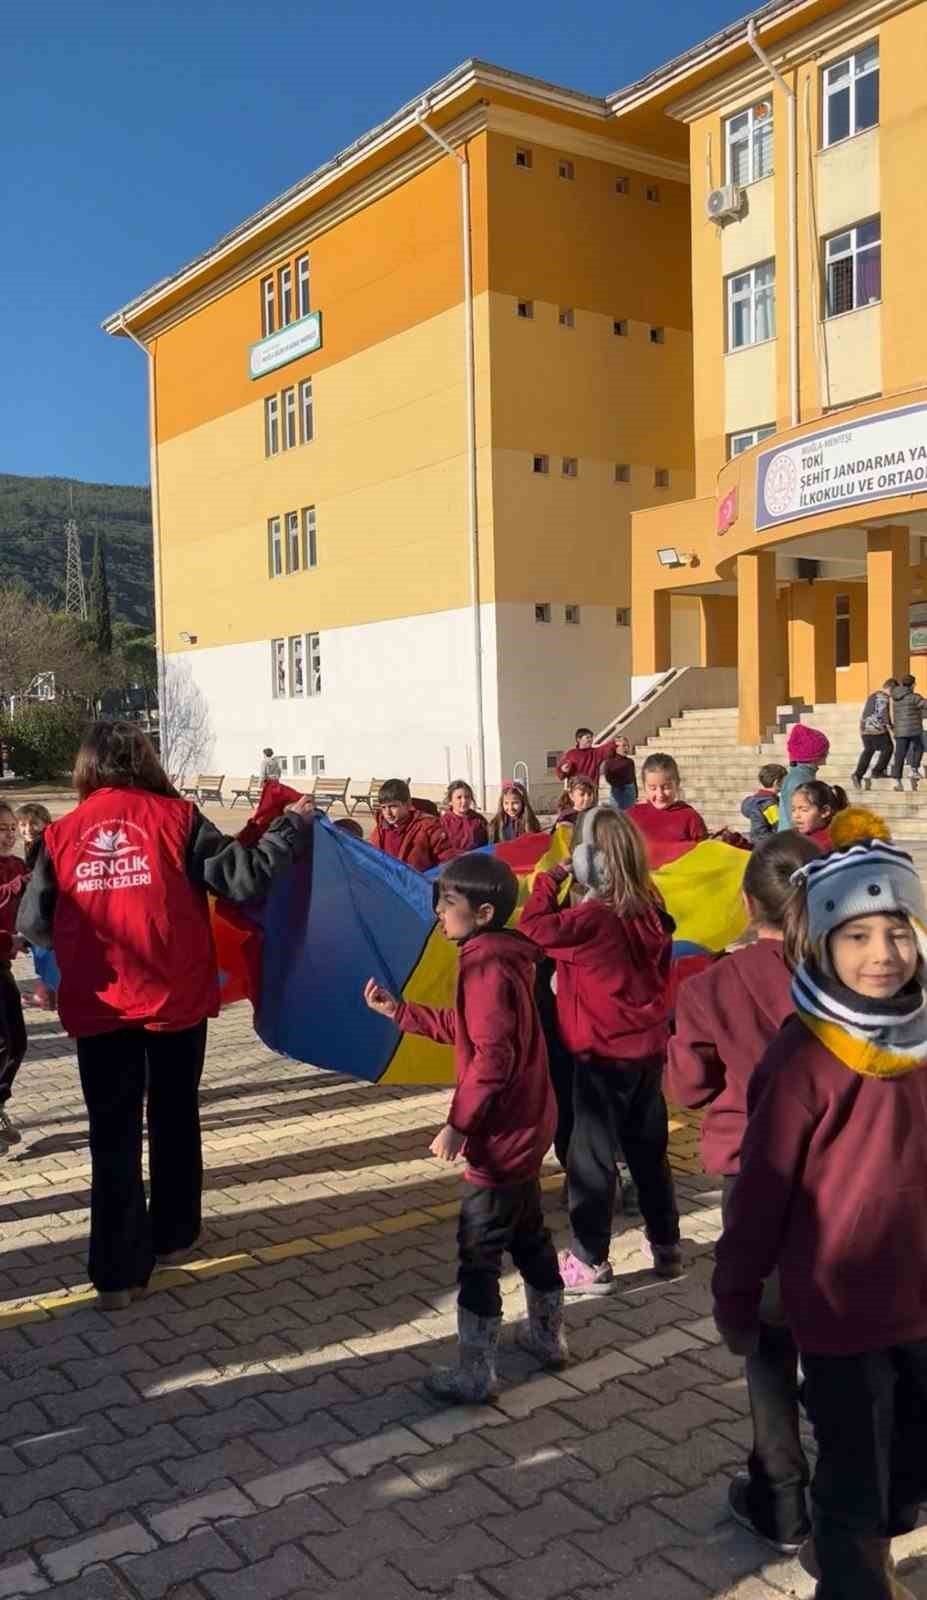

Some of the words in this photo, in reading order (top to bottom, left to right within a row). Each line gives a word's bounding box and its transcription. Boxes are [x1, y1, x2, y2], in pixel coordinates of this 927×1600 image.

[800, 468, 830, 489] ŞEHİT
[834, 451, 905, 480] JANDARMA
[801, 451, 823, 471] TOKİ
[800, 483, 855, 507] İLKOKULU
[858, 477, 873, 493] VE
[877, 466, 927, 488] ORTAO
